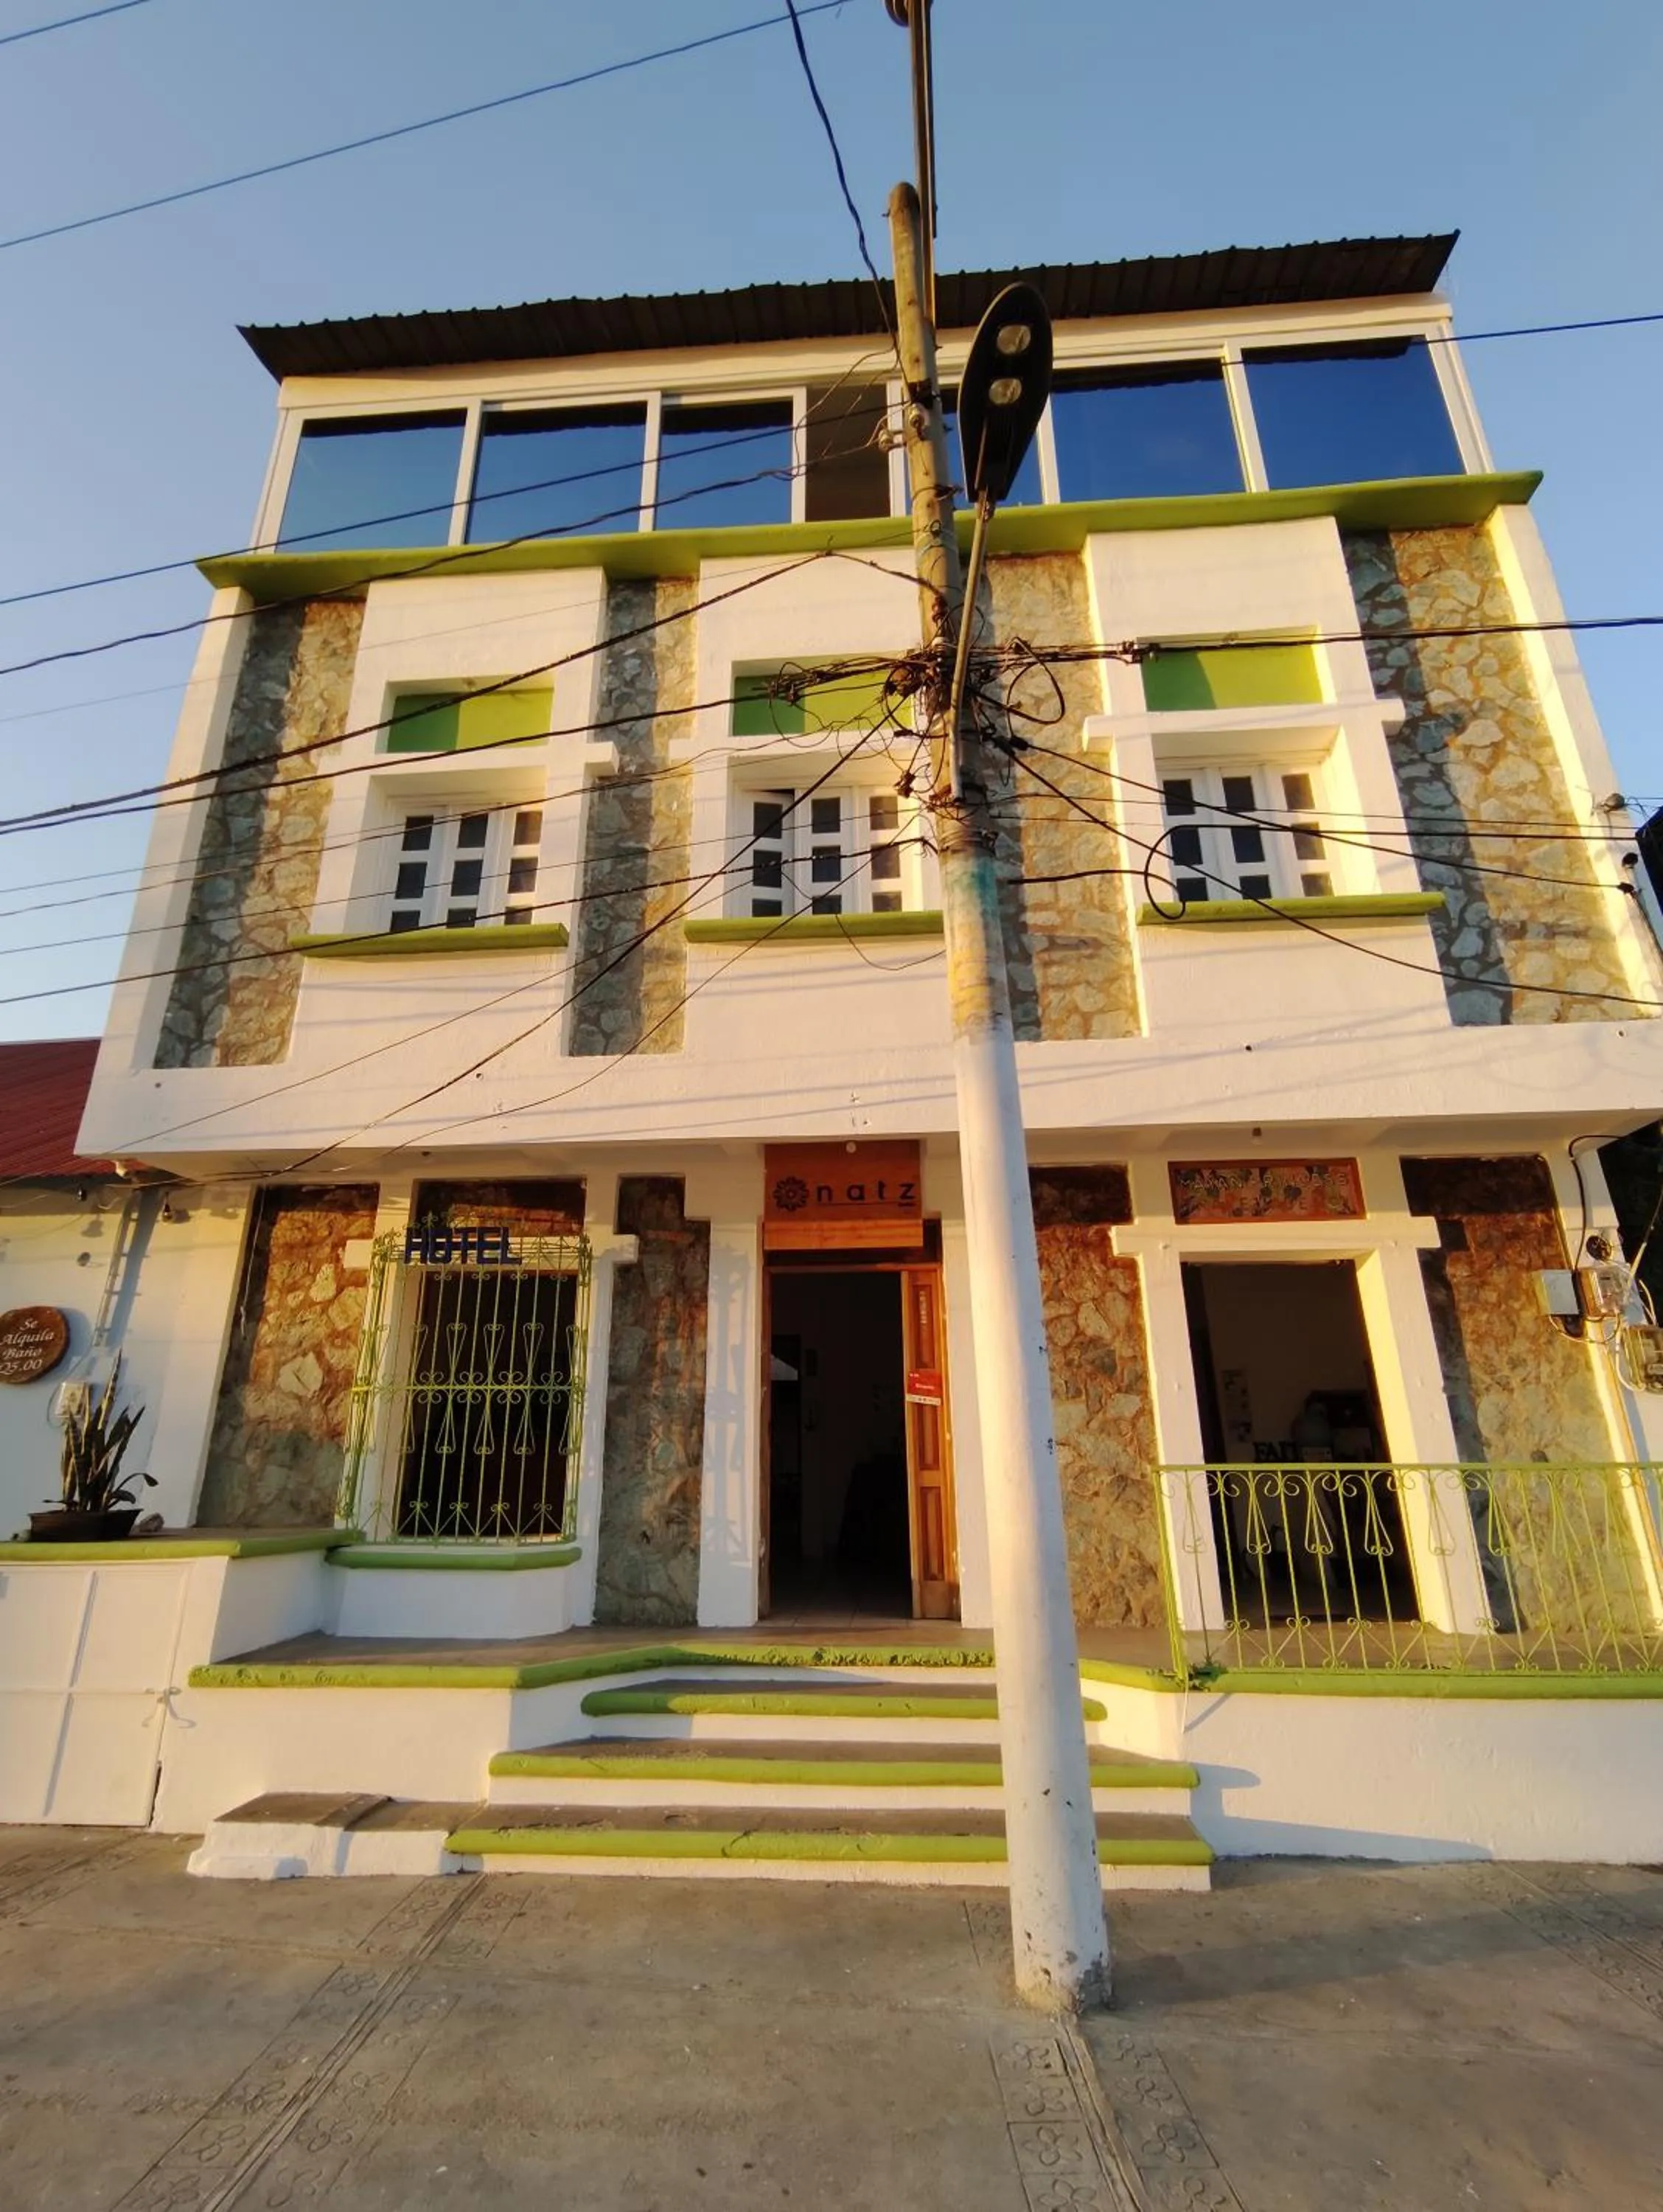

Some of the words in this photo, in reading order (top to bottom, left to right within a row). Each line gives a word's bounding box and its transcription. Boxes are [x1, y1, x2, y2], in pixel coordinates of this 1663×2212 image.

[816, 1180, 916, 1203] natz
[404, 1226, 522, 1265] HOTEL
[19, 1318, 38, 1331] Se
[0, 1328, 55, 1347] Alquila
